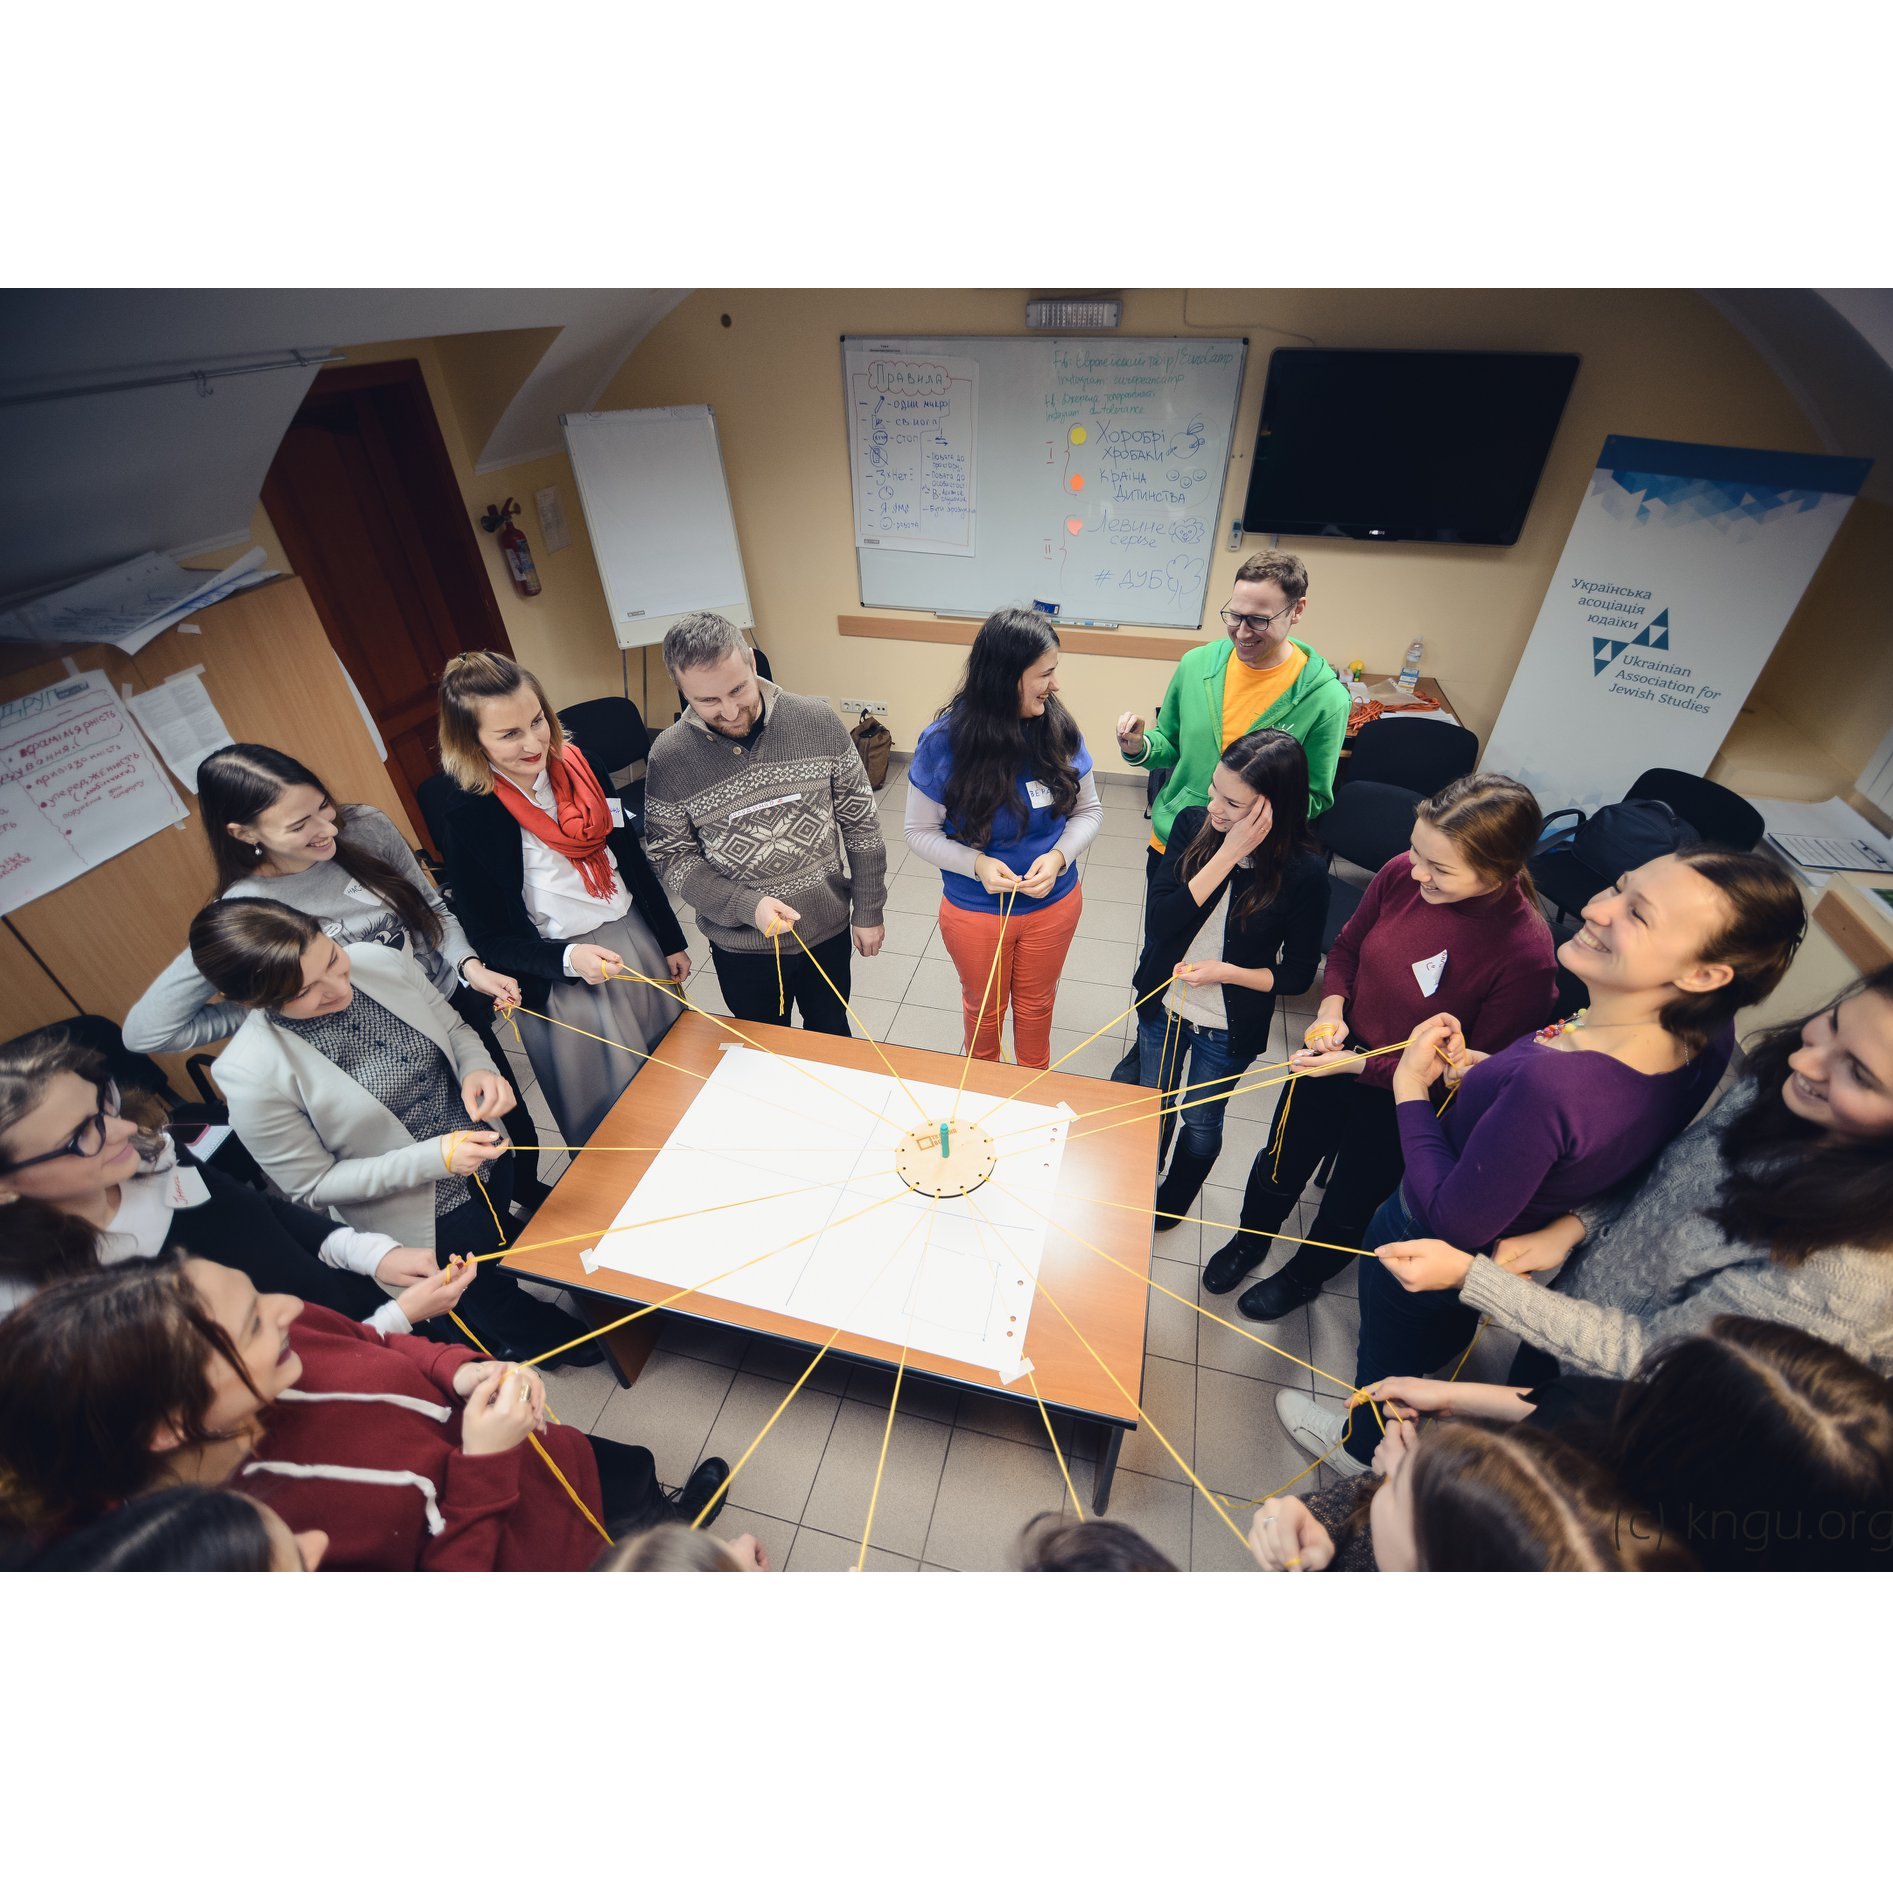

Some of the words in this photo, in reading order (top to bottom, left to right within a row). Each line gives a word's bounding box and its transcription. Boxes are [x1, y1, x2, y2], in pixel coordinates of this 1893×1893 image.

[1571, 577, 1652, 600] Українська
[1578, 596, 1645, 615] асоціація
[1587, 613, 1639, 630] юдаїки
[1622, 655, 1692, 678] Ukrainian
[1615, 669, 1695, 695] Association
[1696, 685, 1722, 700] for
[1609, 683, 1655, 701] Jewish
[1658, 693, 1711, 715] Studies
